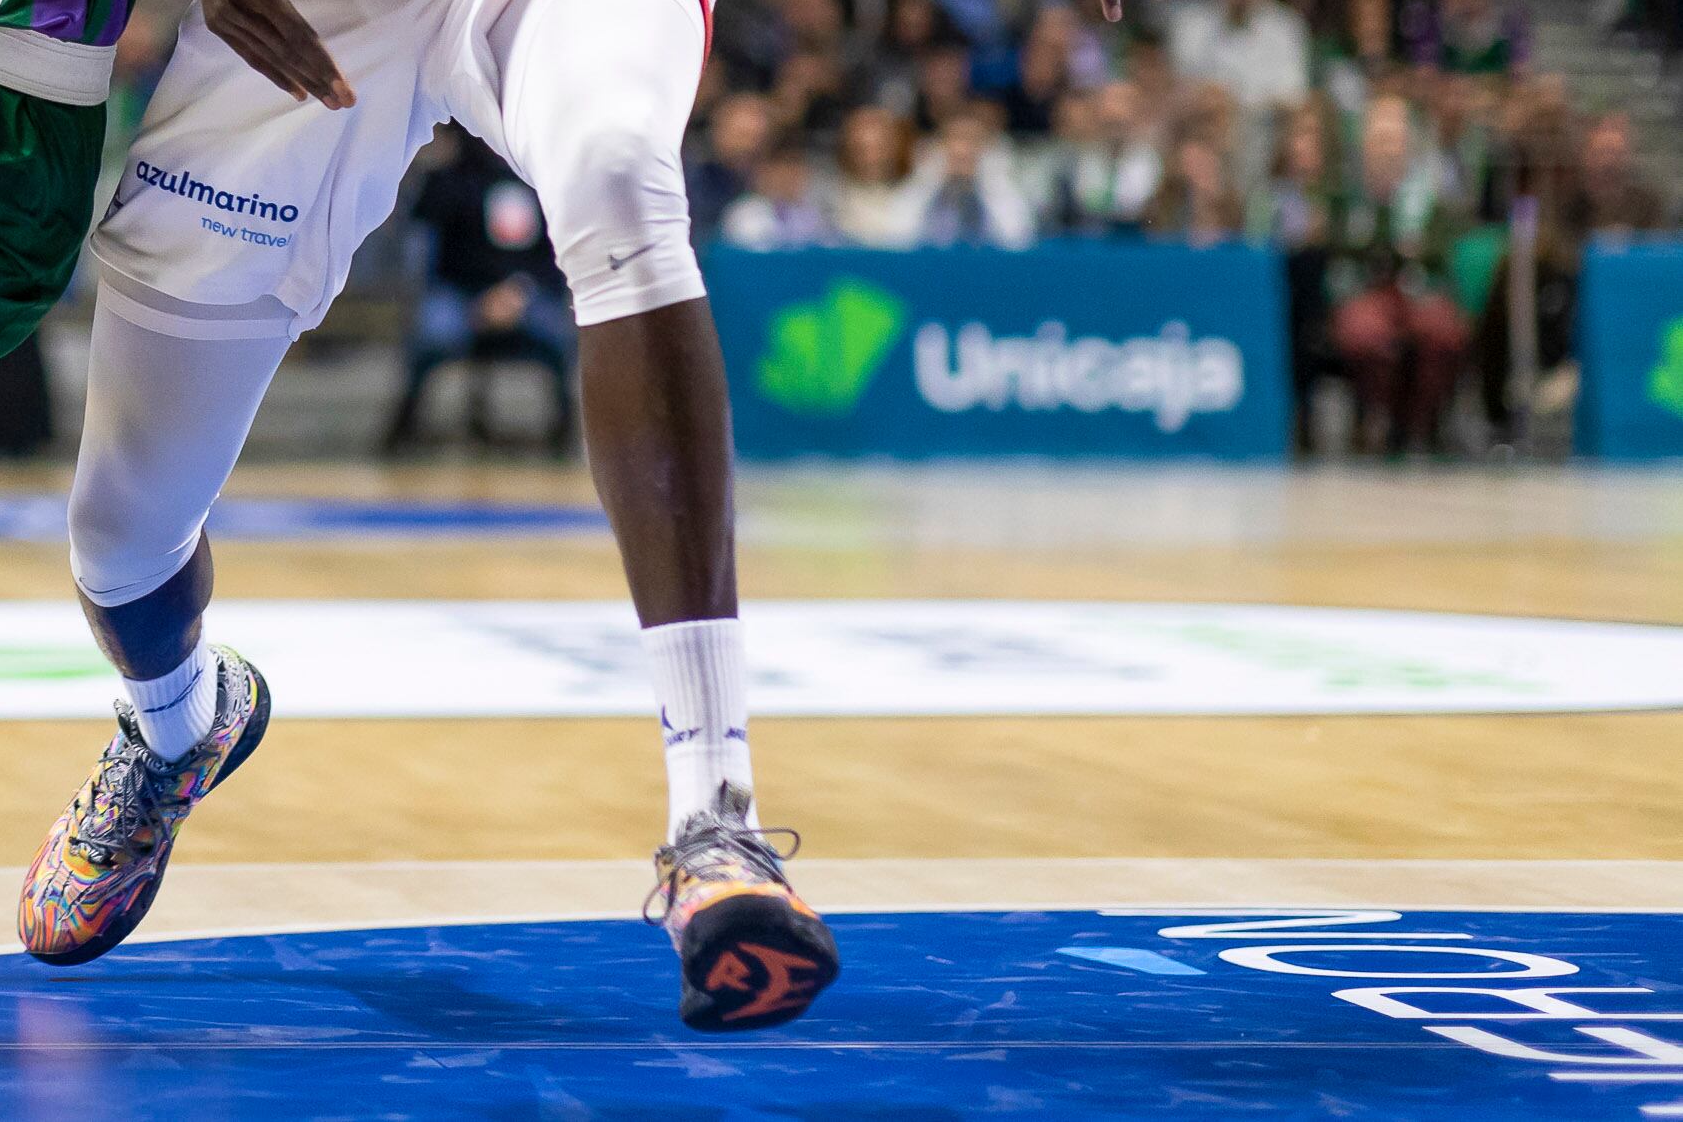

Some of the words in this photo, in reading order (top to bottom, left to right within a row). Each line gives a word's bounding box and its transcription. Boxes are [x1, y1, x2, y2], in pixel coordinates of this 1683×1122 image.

[136, 160, 298, 223] azulmarino
[202, 216, 238, 238] new
[914, 318, 1243, 434] Unicaja
